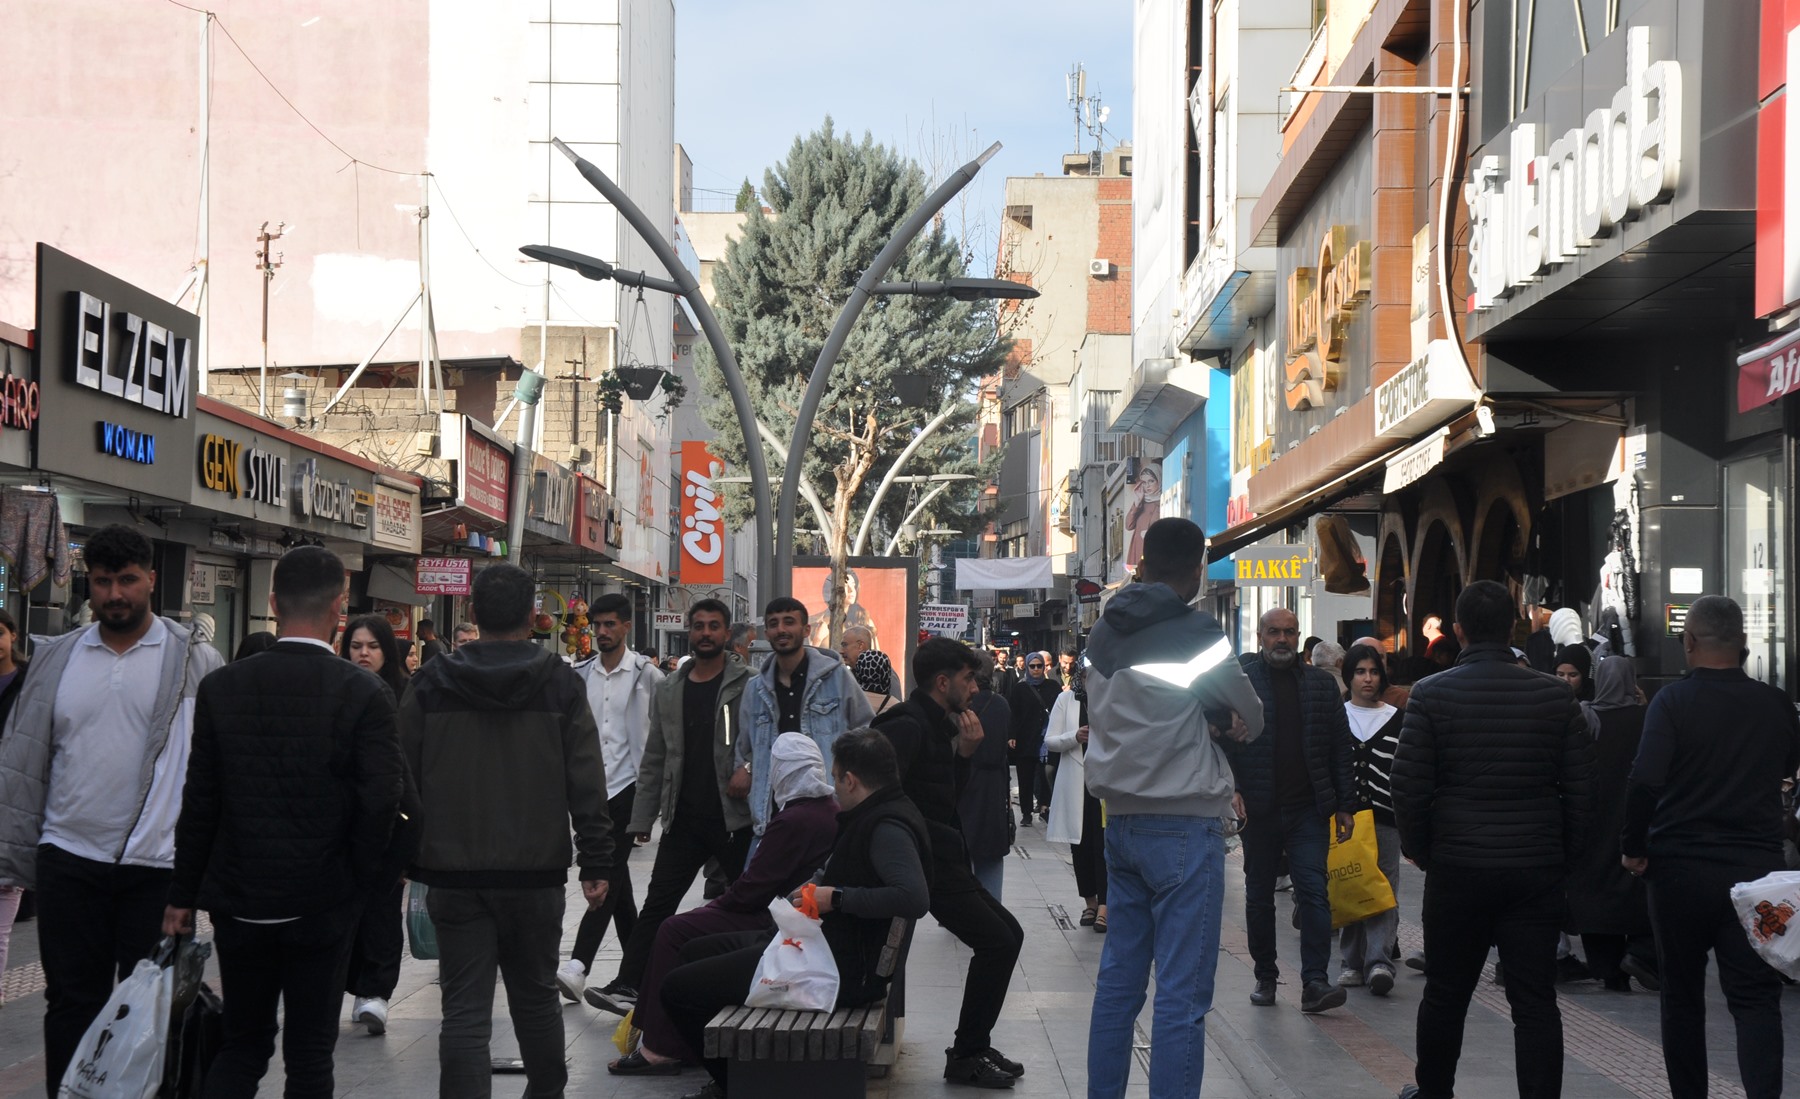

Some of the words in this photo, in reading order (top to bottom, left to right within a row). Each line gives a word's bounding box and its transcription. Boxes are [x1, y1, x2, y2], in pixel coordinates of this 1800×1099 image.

[68, 290, 192, 419] ELZEM
[101, 421, 155, 465] WOMAN
[202, 433, 243, 499] GENÇ
[249, 448, 288, 508] STYLE
[312, 468, 356, 526] ÖZDEMİR
[445, 559, 469, 568] USTA
